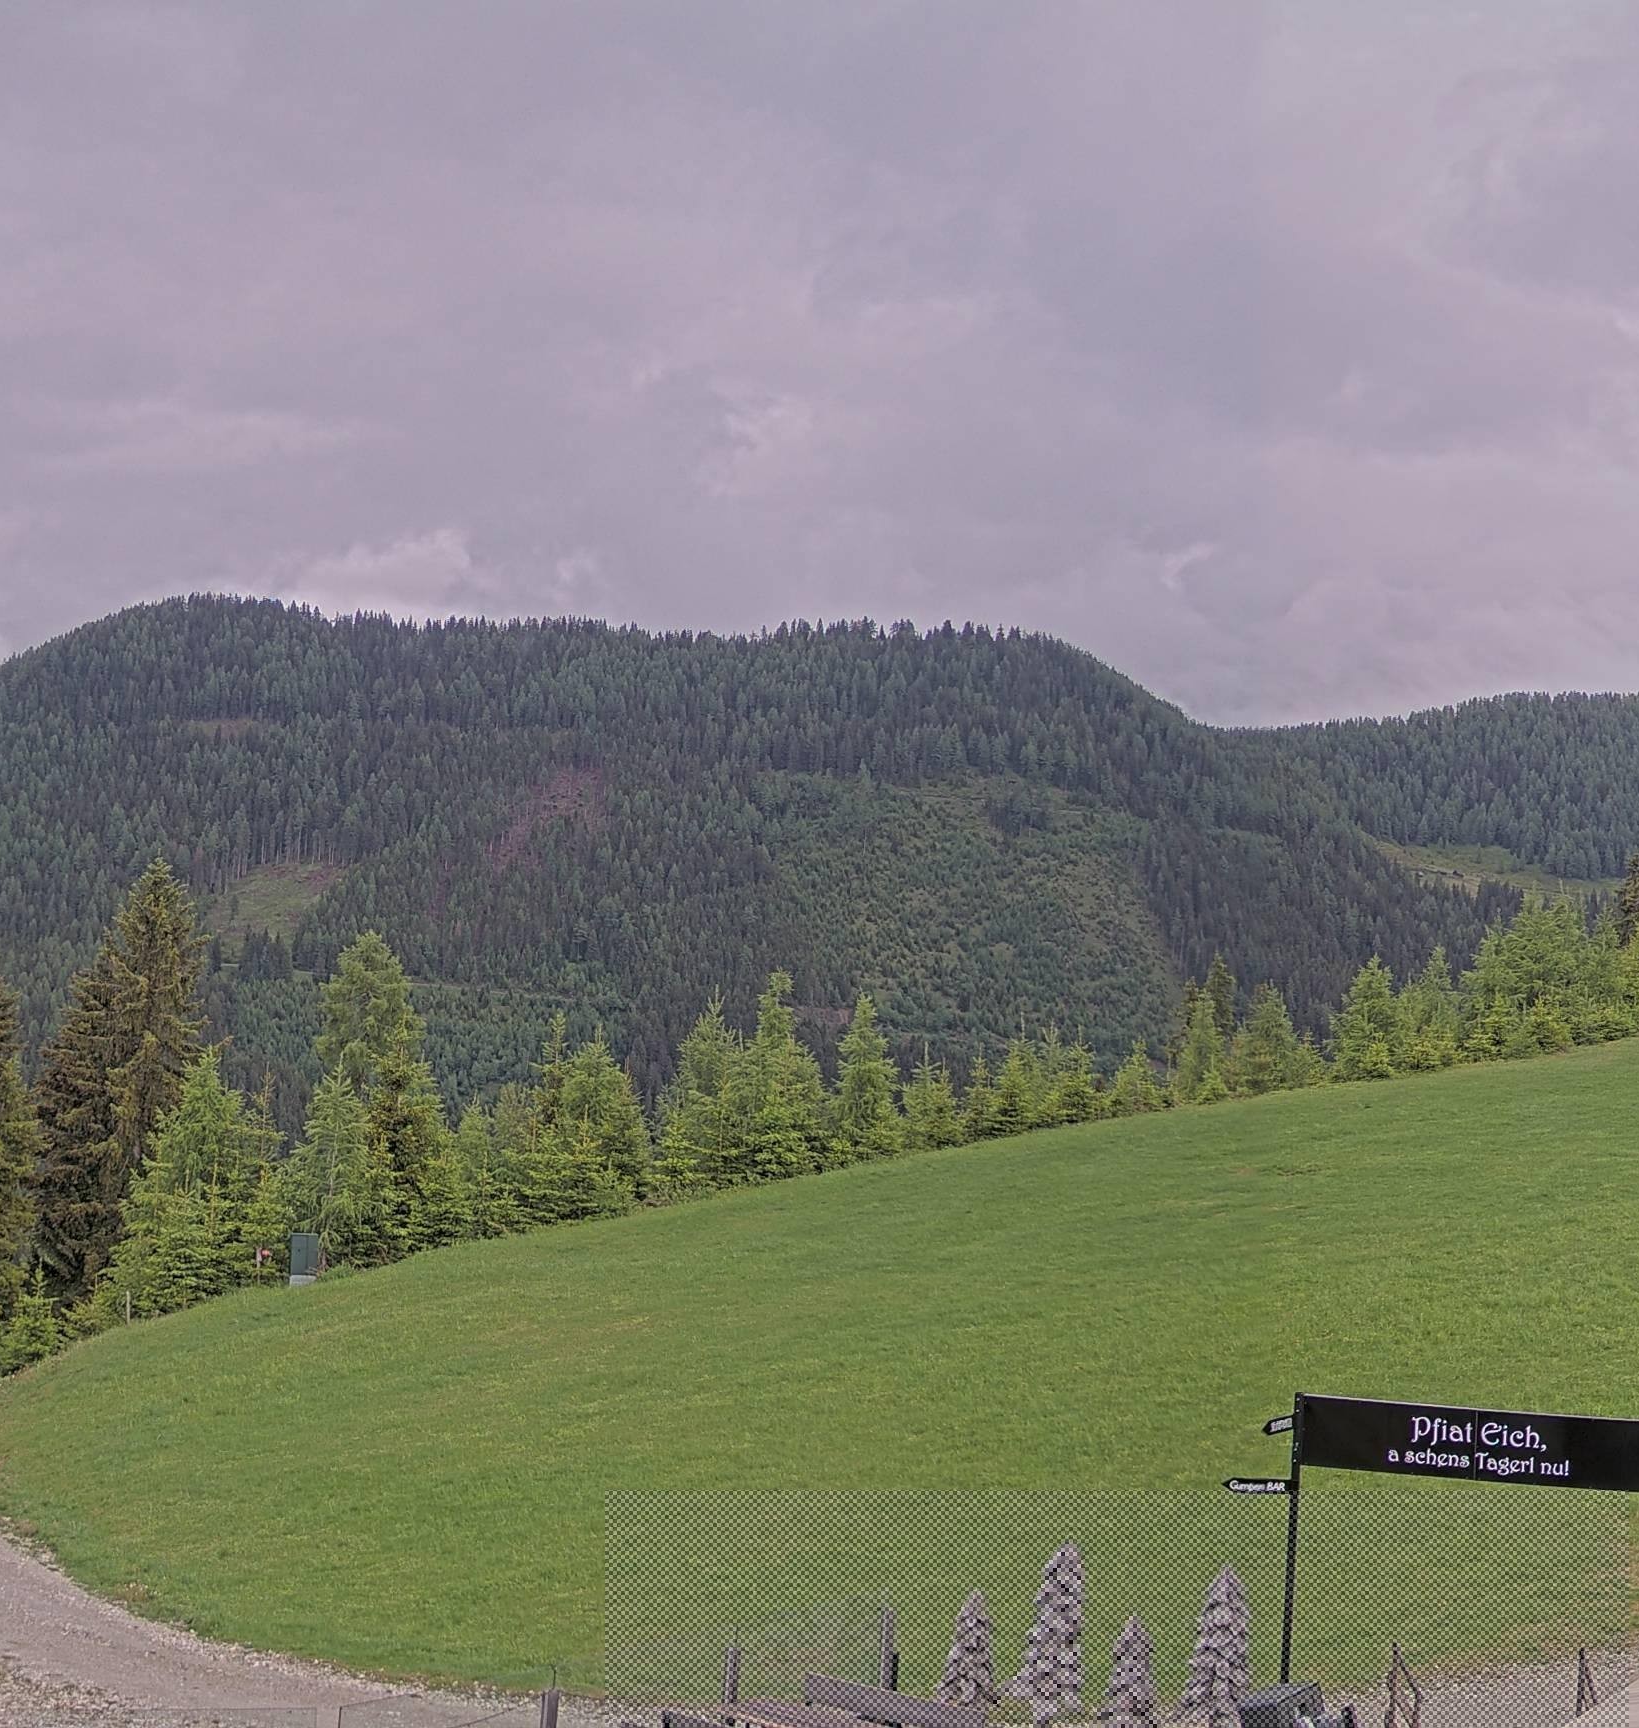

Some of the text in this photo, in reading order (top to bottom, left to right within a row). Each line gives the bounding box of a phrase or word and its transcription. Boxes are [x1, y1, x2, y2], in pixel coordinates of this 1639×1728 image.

[1411, 1416, 1547, 1452] Pfiat Eich,
[1388, 1448, 1570, 1476] a schens Tagerl nu!
[1266, 1481, 1286, 1492] BAR
